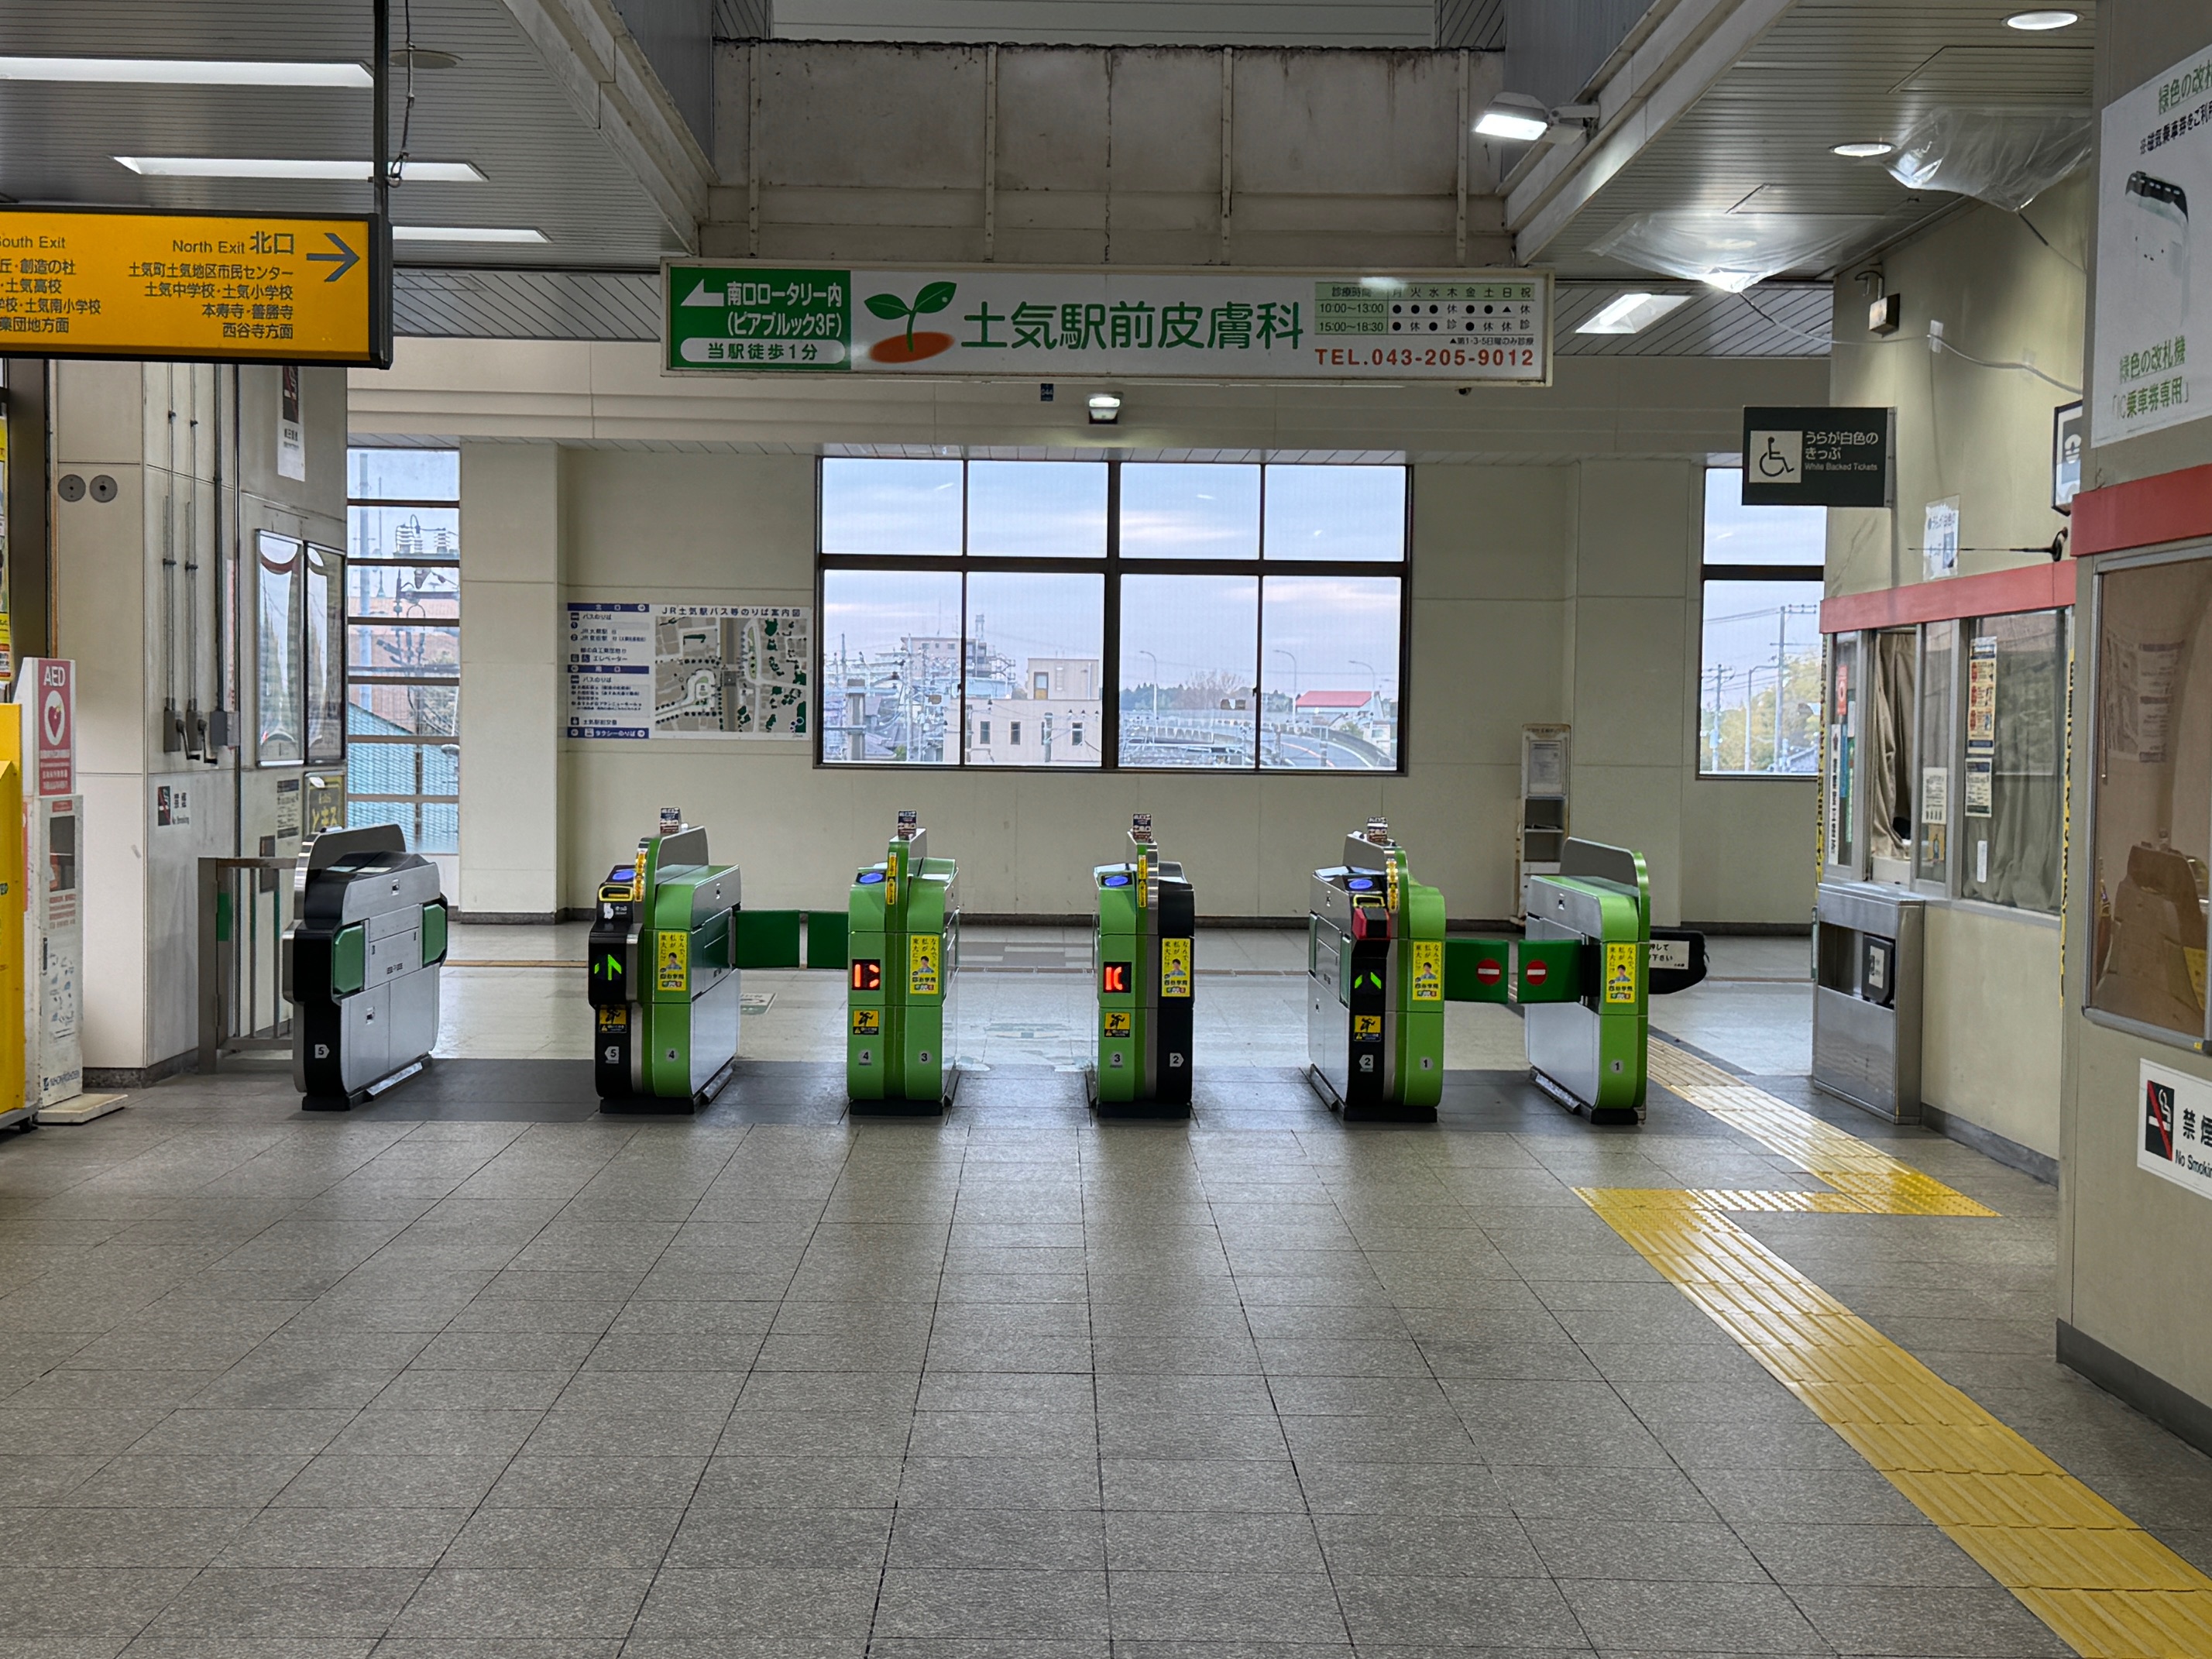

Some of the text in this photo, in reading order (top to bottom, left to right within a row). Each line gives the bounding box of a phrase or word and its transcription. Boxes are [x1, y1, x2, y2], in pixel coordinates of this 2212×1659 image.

[39, 235, 66, 249] Exit
[173, 240, 245, 254] North Exit
[249, 231, 294, 255] 北口
[726, 281, 842, 307] 南口ロータリー内
[1410, 287, 1421, 297] 火
[1429, 287, 1439, 297] 水
[1448, 287, 1458, 297] 木
[1466, 287, 1475, 297] 金
[1484, 287, 1495, 297] 土
[1503, 287, 1511, 297] 日
[961, 301, 1304, 350] 土気駅前皮膚科
[708, 342, 818, 361] 当駅徒歩1分
[1314, 348, 1534, 366] TEL.043-205-9012
[2119, 335, 2186, 385] 緑色の改札機
[1805, 431, 1878, 445] うらが白色の
[1805, 447, 1842, 461] きっぷ
[43, 666, 66, 687] AED
[318, 1046, 325, 1056] 5
[610, 1049, 617, 1058] 5
[668, 1049, 675, 1060] 4
[863, 1051, 869, 1060] 4
[921, 1053, 928, 1062] 3
[1114, 1053, 1121, 1063] 3
[1173, 1055, 1179, 1064] 2
[1364, 1057, 1371, 1066] 2
[1615, 1062, 1620, 1070] 1
[2175, 1149, 2186, 1166] No
